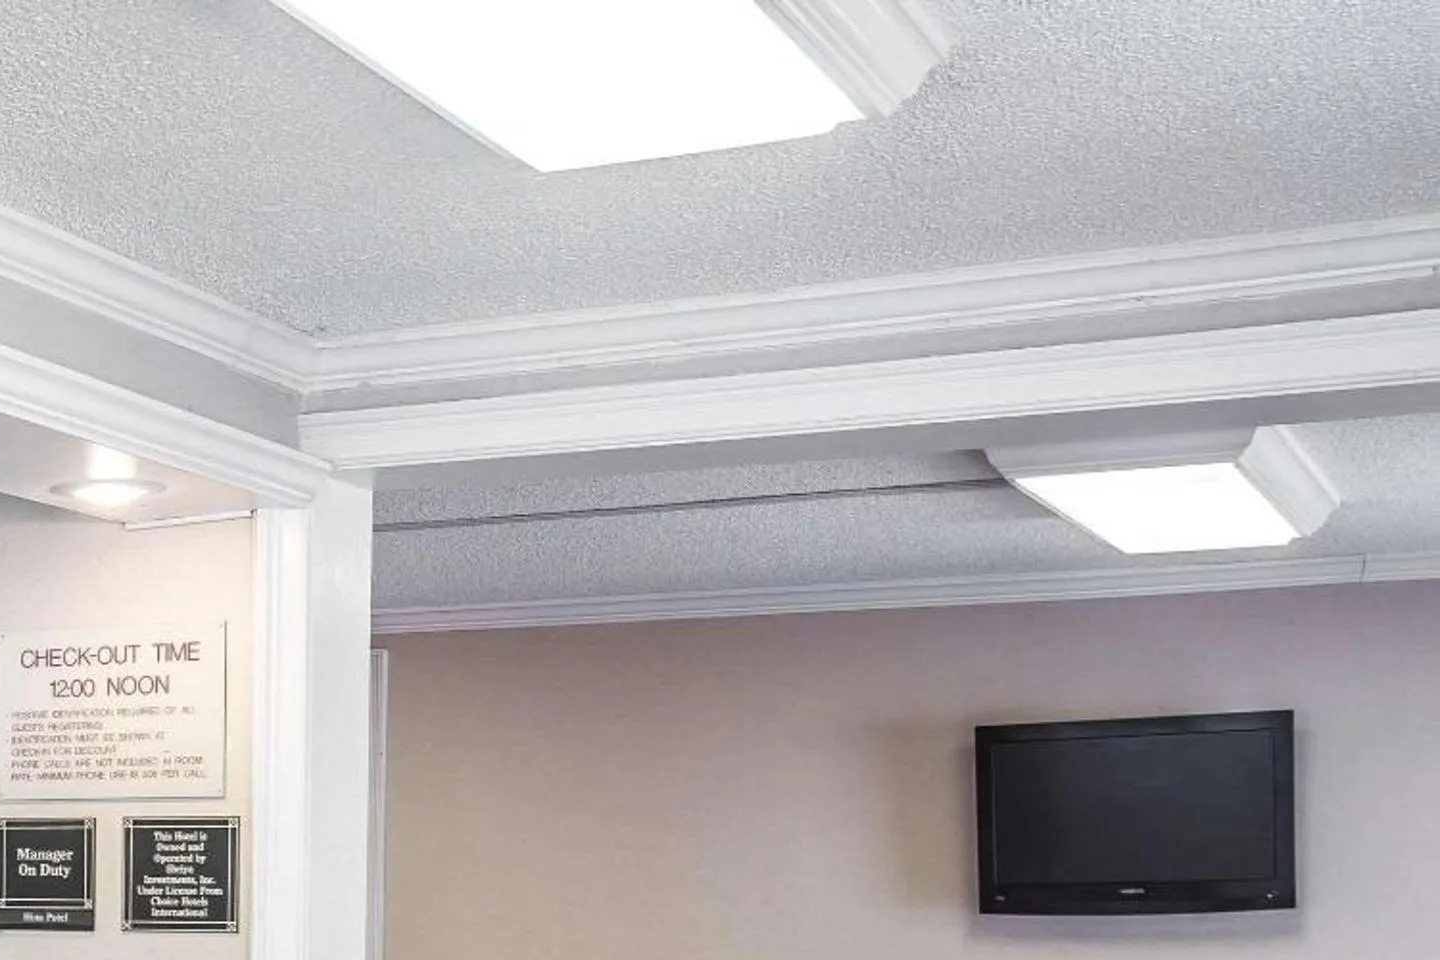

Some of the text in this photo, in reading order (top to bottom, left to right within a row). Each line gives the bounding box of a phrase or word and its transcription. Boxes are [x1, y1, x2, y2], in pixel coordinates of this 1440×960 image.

[20, 641, 201, 668] CHECK-OUT TIME
[107, 675, 170, 697] NOON
[16, 848, 74, 862] Manager
[18, 863, 72, 879] On Duty
